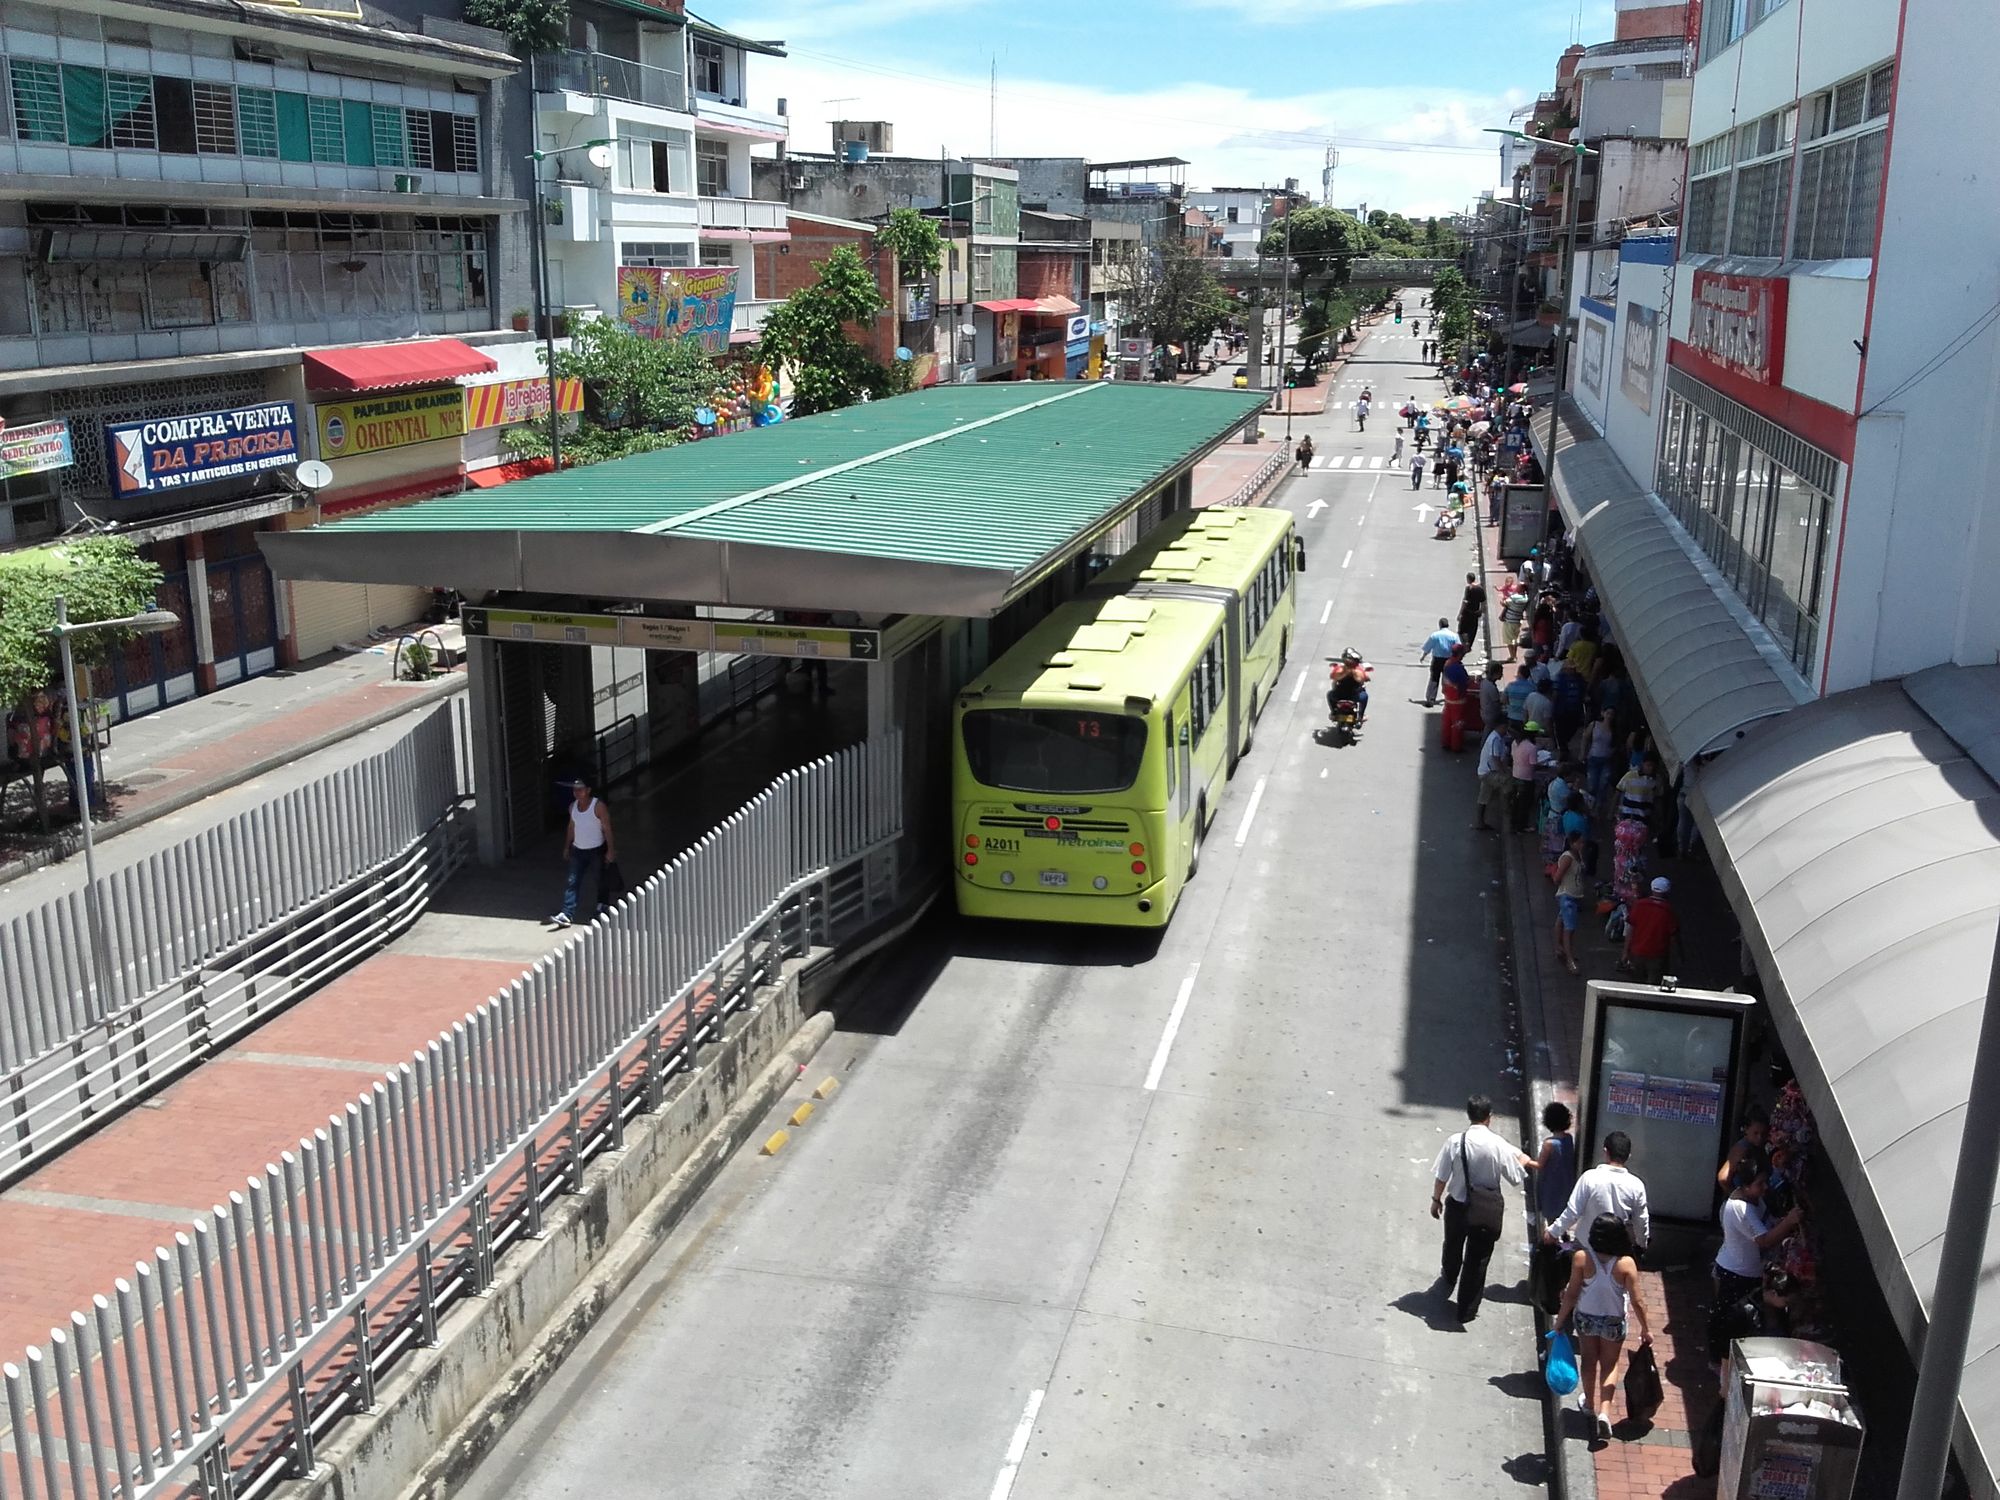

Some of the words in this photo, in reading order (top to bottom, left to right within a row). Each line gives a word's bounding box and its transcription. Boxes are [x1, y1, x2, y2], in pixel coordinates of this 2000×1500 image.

[685, 274, 726, 297] Gigante
[353, 401, 412, 419] PAPELERIA
[143, 405, 293, 445] COMPRA-VENTA
[356, 415, 431, 449] ORIENTAL
[28, 440, 62, 456] CENTRO
[152, 446, 188, 472] DA
[193, 429, 294, 465] PRECISA
[147, 474, 181, 490] JYAS
[182, 472, 190, 483] Y
[192, 464, 245, 482] ARTICULOS
[246, 462, 257, 472] EN
[259, 453, 298, 469] GENERAL
[985, 837, 1020, 850] A2011
